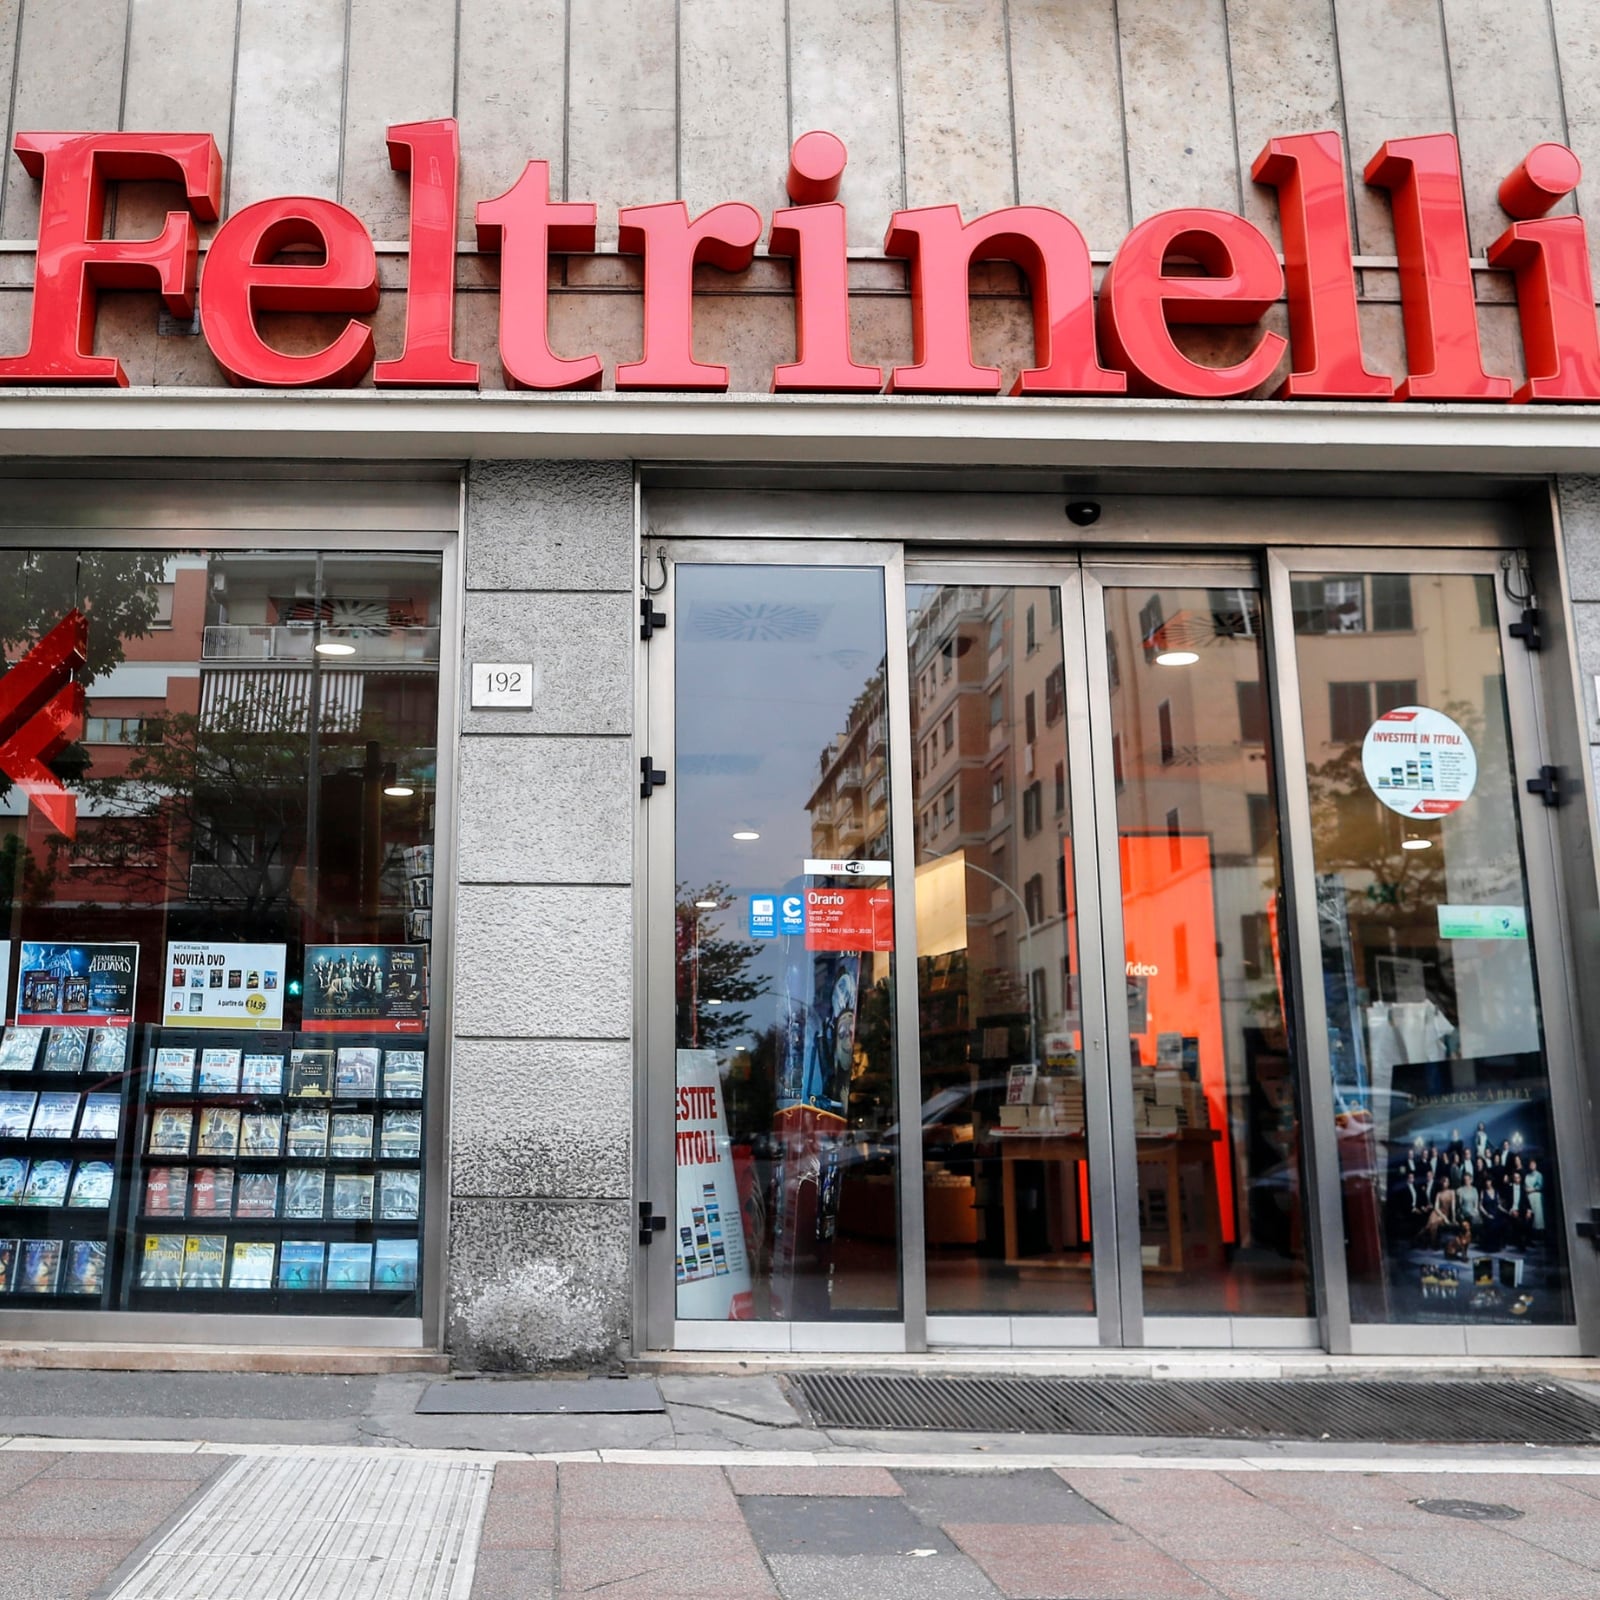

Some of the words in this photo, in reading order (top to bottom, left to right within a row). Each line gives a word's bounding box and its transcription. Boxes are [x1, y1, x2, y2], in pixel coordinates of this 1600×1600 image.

[0, 117, 1600, 403] Feltrinelli
[487, 672, 521, 692] 192
[1373, 732, 1417, 743] INVESTITE
[1420, 734, 1430, 744] IN
[808, 892, 844, 905] Orario
[88, 956, 132, 973] ADDAMS
[173, 952, 205, 965] NOVITÀ
[207, 954, 225, 966] DVD
